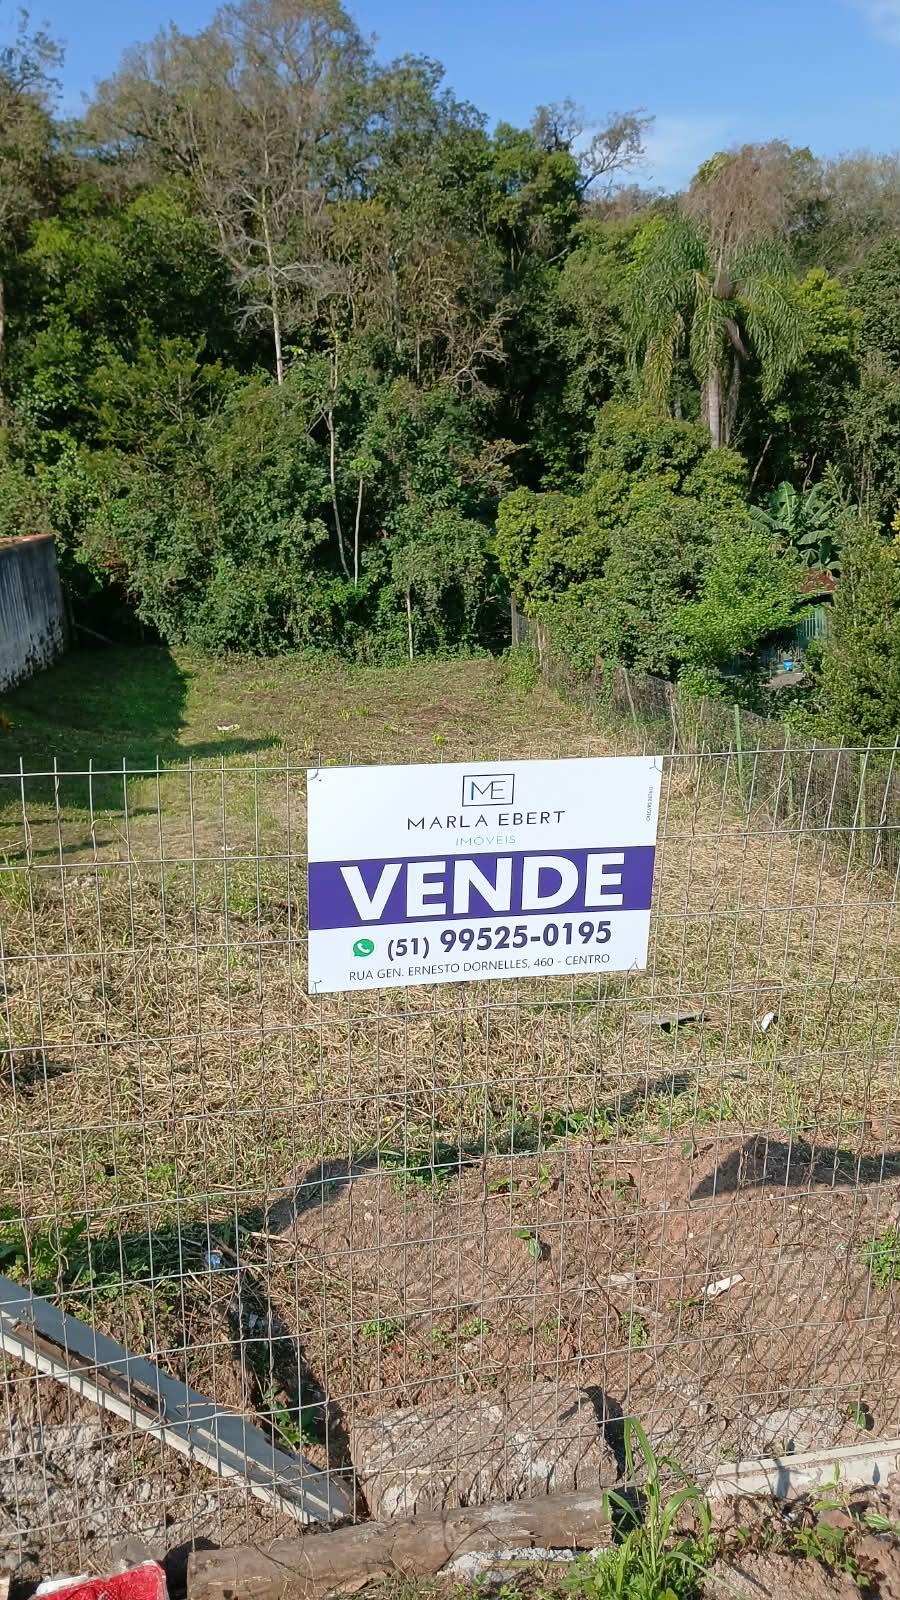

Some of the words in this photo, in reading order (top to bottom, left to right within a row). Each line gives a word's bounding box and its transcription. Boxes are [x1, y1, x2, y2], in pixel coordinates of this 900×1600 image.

[471, 780, 506, 801] ME
[408, 814, 489, 830] MARLA
[498, 811, 566, 826] EBERT
[340, 852, 625, 921] VENDE
[387, 937, 430, 961] (51)
[440, 921, 612, 953] 99525-0195
[349, 970, 373, 981] RUA
[377, 966, 405, 978] GEN.
[408, 963, 459, 976] ERNESTO
[463, 958, 530, 972] DORNELLES,
[534, 957, 553, 968] 460
[565, 953, 610, 965] CENTRO
